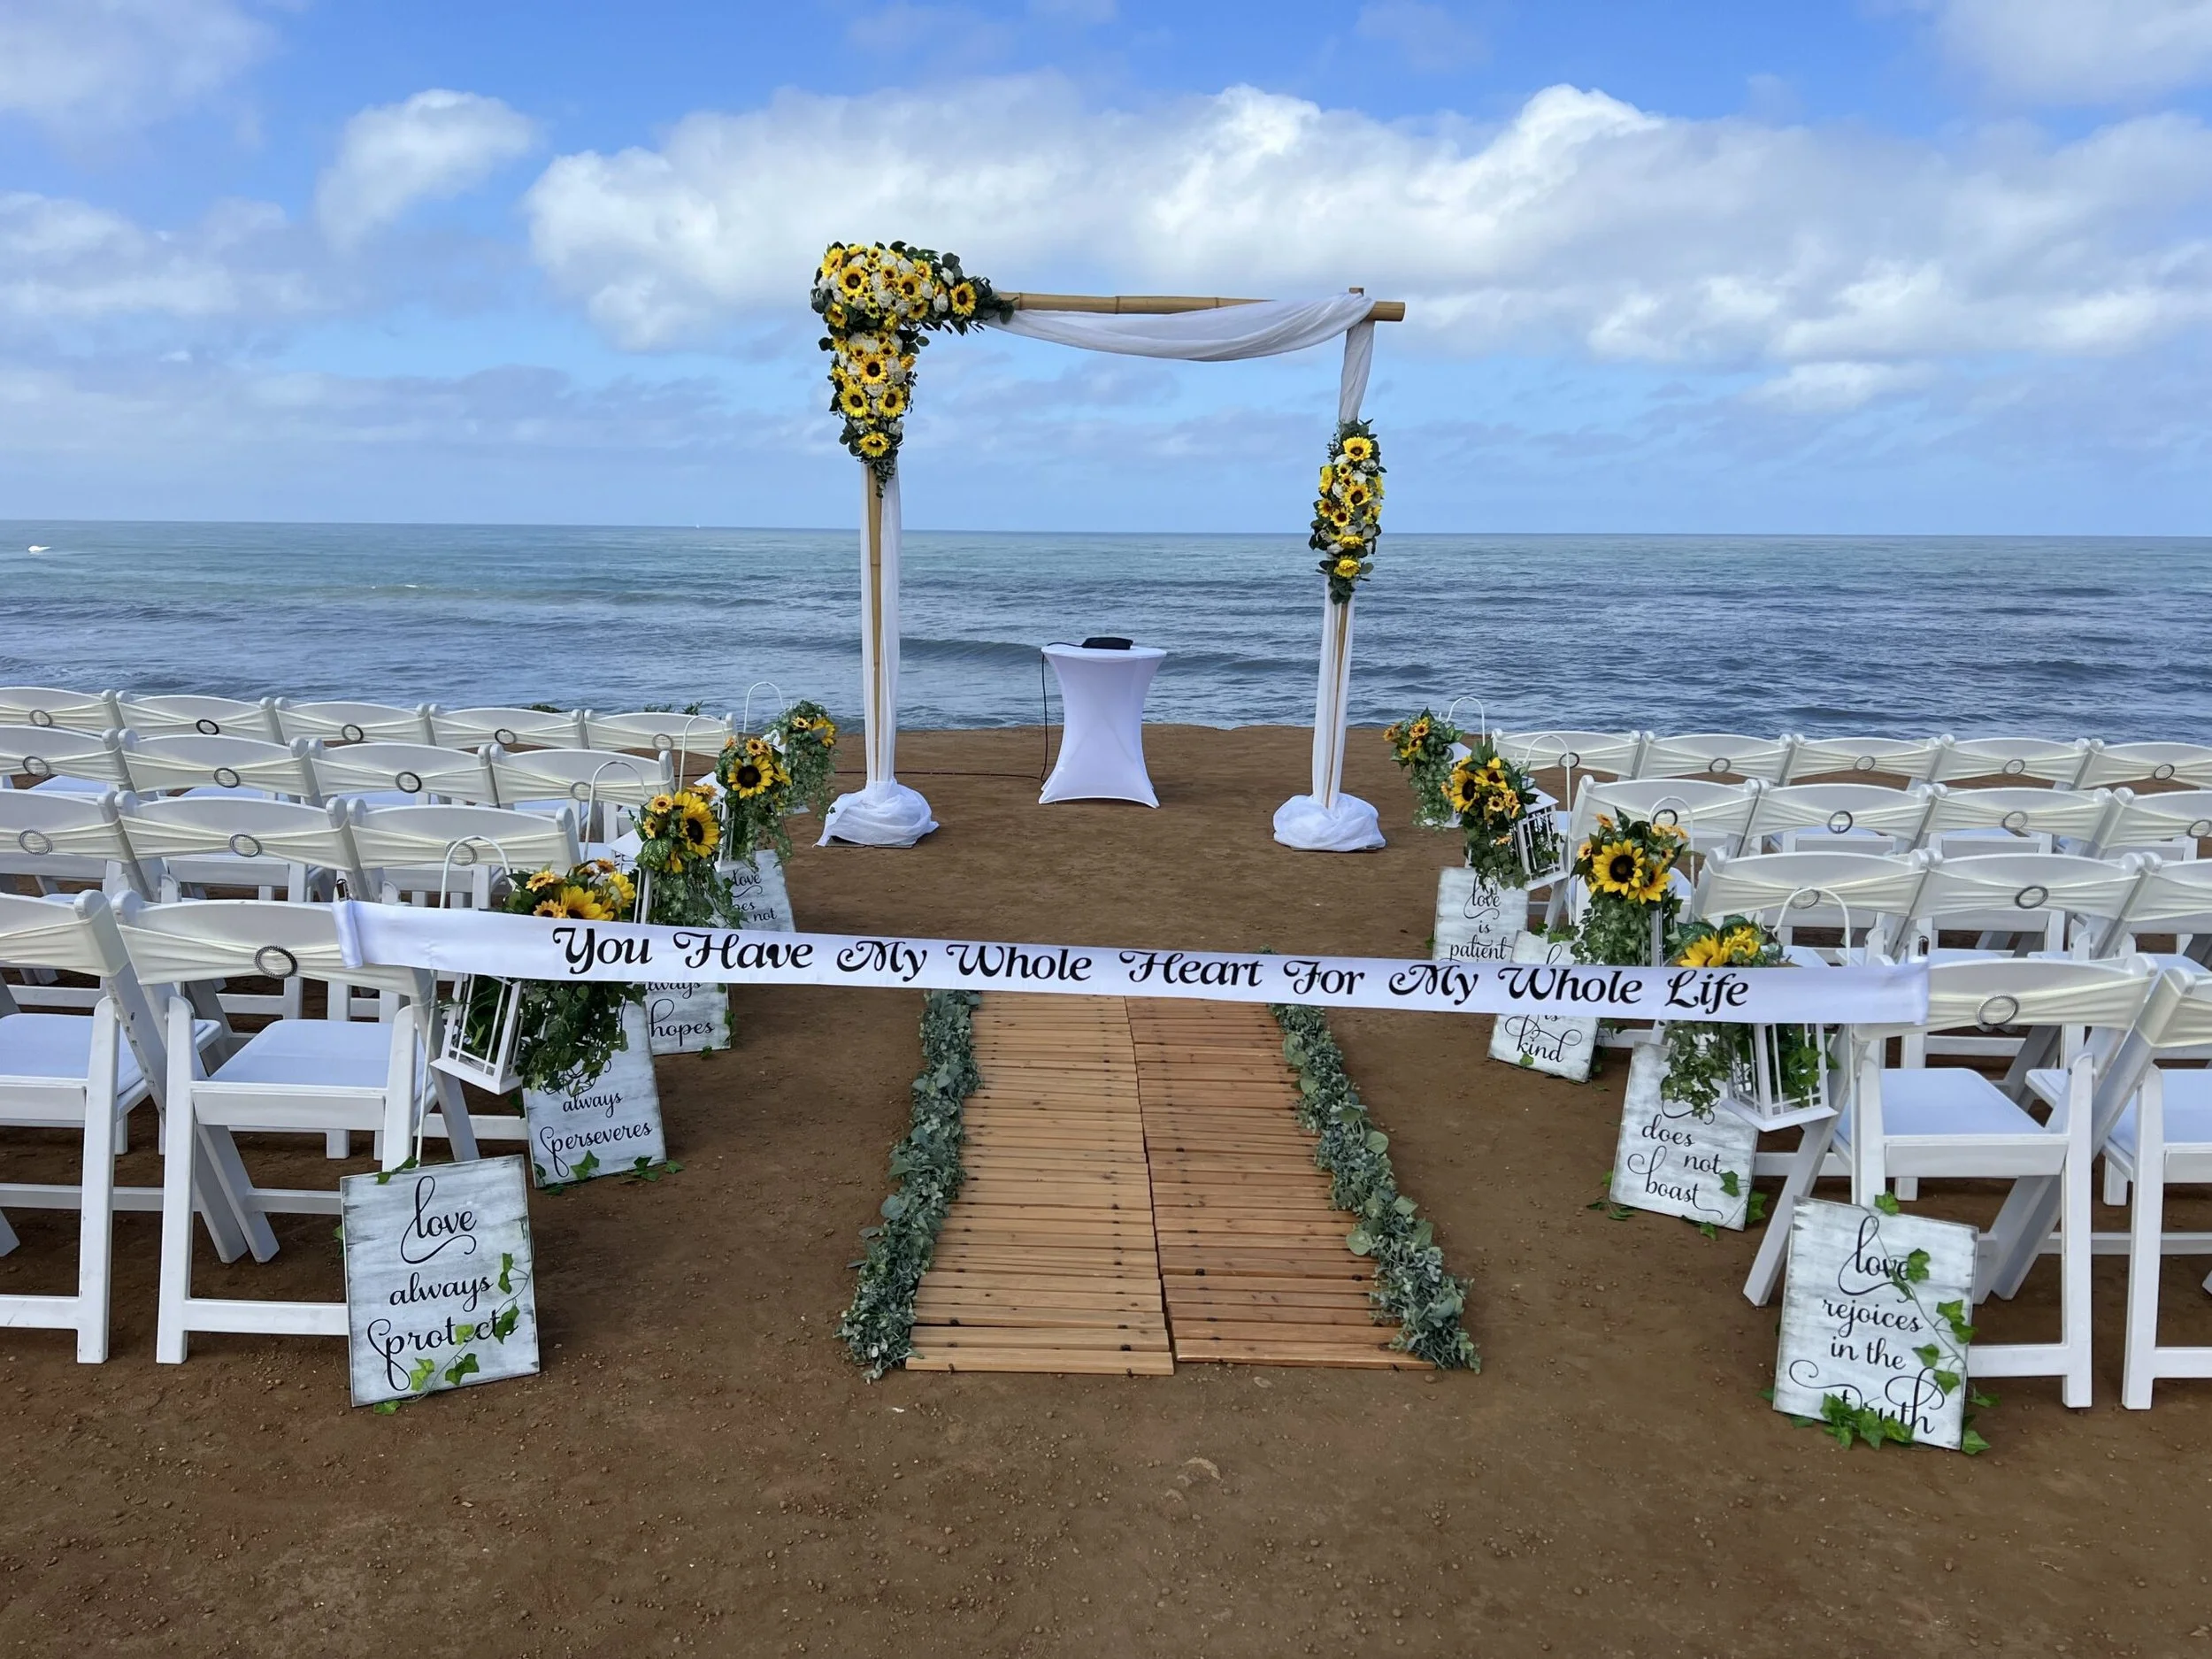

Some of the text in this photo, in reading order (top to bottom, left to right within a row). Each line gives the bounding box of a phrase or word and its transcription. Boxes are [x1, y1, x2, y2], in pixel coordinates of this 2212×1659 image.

[753, 908, 778, 922] not
[1463, 873, 1501, 920] love
[1479, 920, 1492, 933] is
[1448, 934, 1514, 962] patient
[553, 927, 1749, 1015] You Have My Whole Heart For My Whole Life
[649, 998, 715, 1048] hopes
[1505, 1014, 1583, 1063] kind
[563, 1090, 623, 1118] always
[540, 1122, 653, 1178] perseveres
[1641, 1114, 1695, 1148] does
[1627, 1145, 1724, 1220] boast
[1683, 1153, 1722, 1175] not
[401, 1175, 477, 1264] love
[1838, 1215, 1909, 1303] love
[389, 1272, 494, 1312] always
[1823, 1299, 1924, 1338] rejoices
[1831, 1336, 1906, 1371] in the
